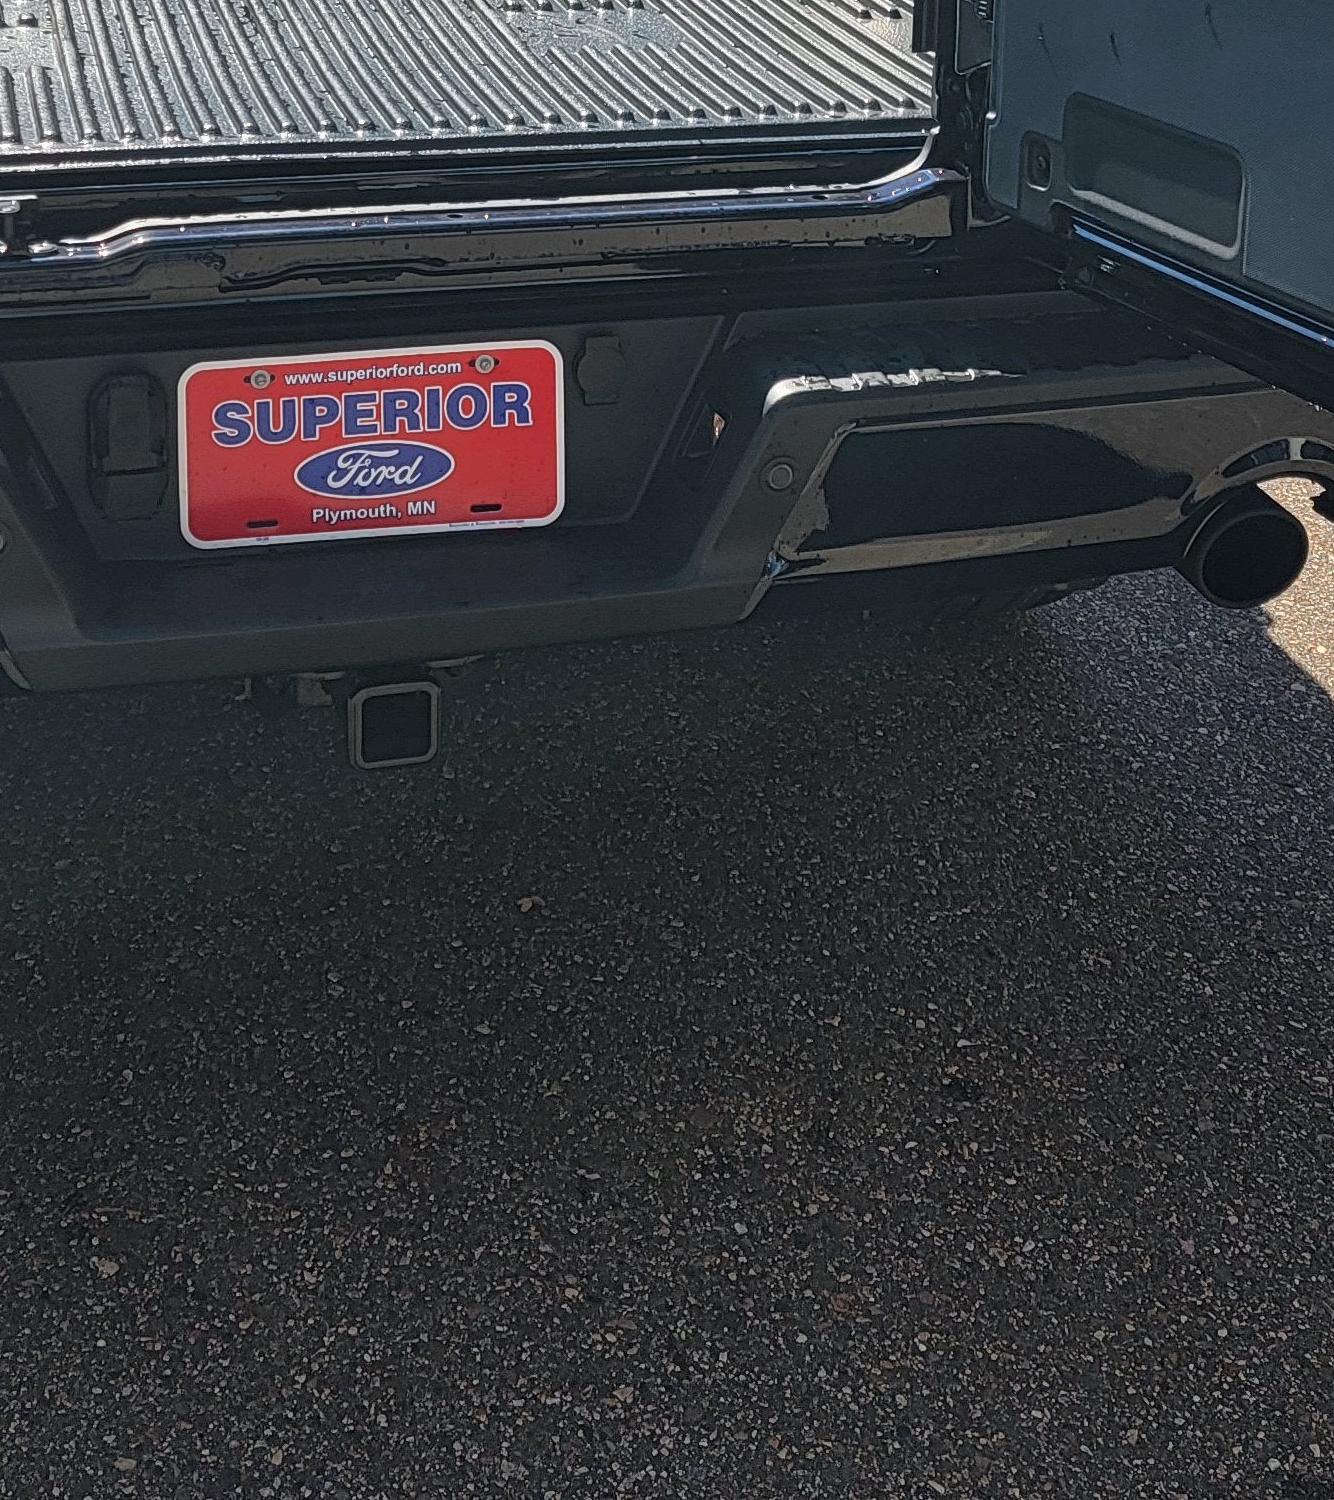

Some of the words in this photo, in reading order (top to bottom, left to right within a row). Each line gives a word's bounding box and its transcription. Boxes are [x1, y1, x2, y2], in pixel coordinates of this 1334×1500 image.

[283, 360, 462, 386] www.superiorford.com
[211, 381, 534, 448] SUPERIOR
[326, 448, 423, 489] Ford
[312, 503, 403, 524] Plymouth,
[407, 500, 437, 517] MN
